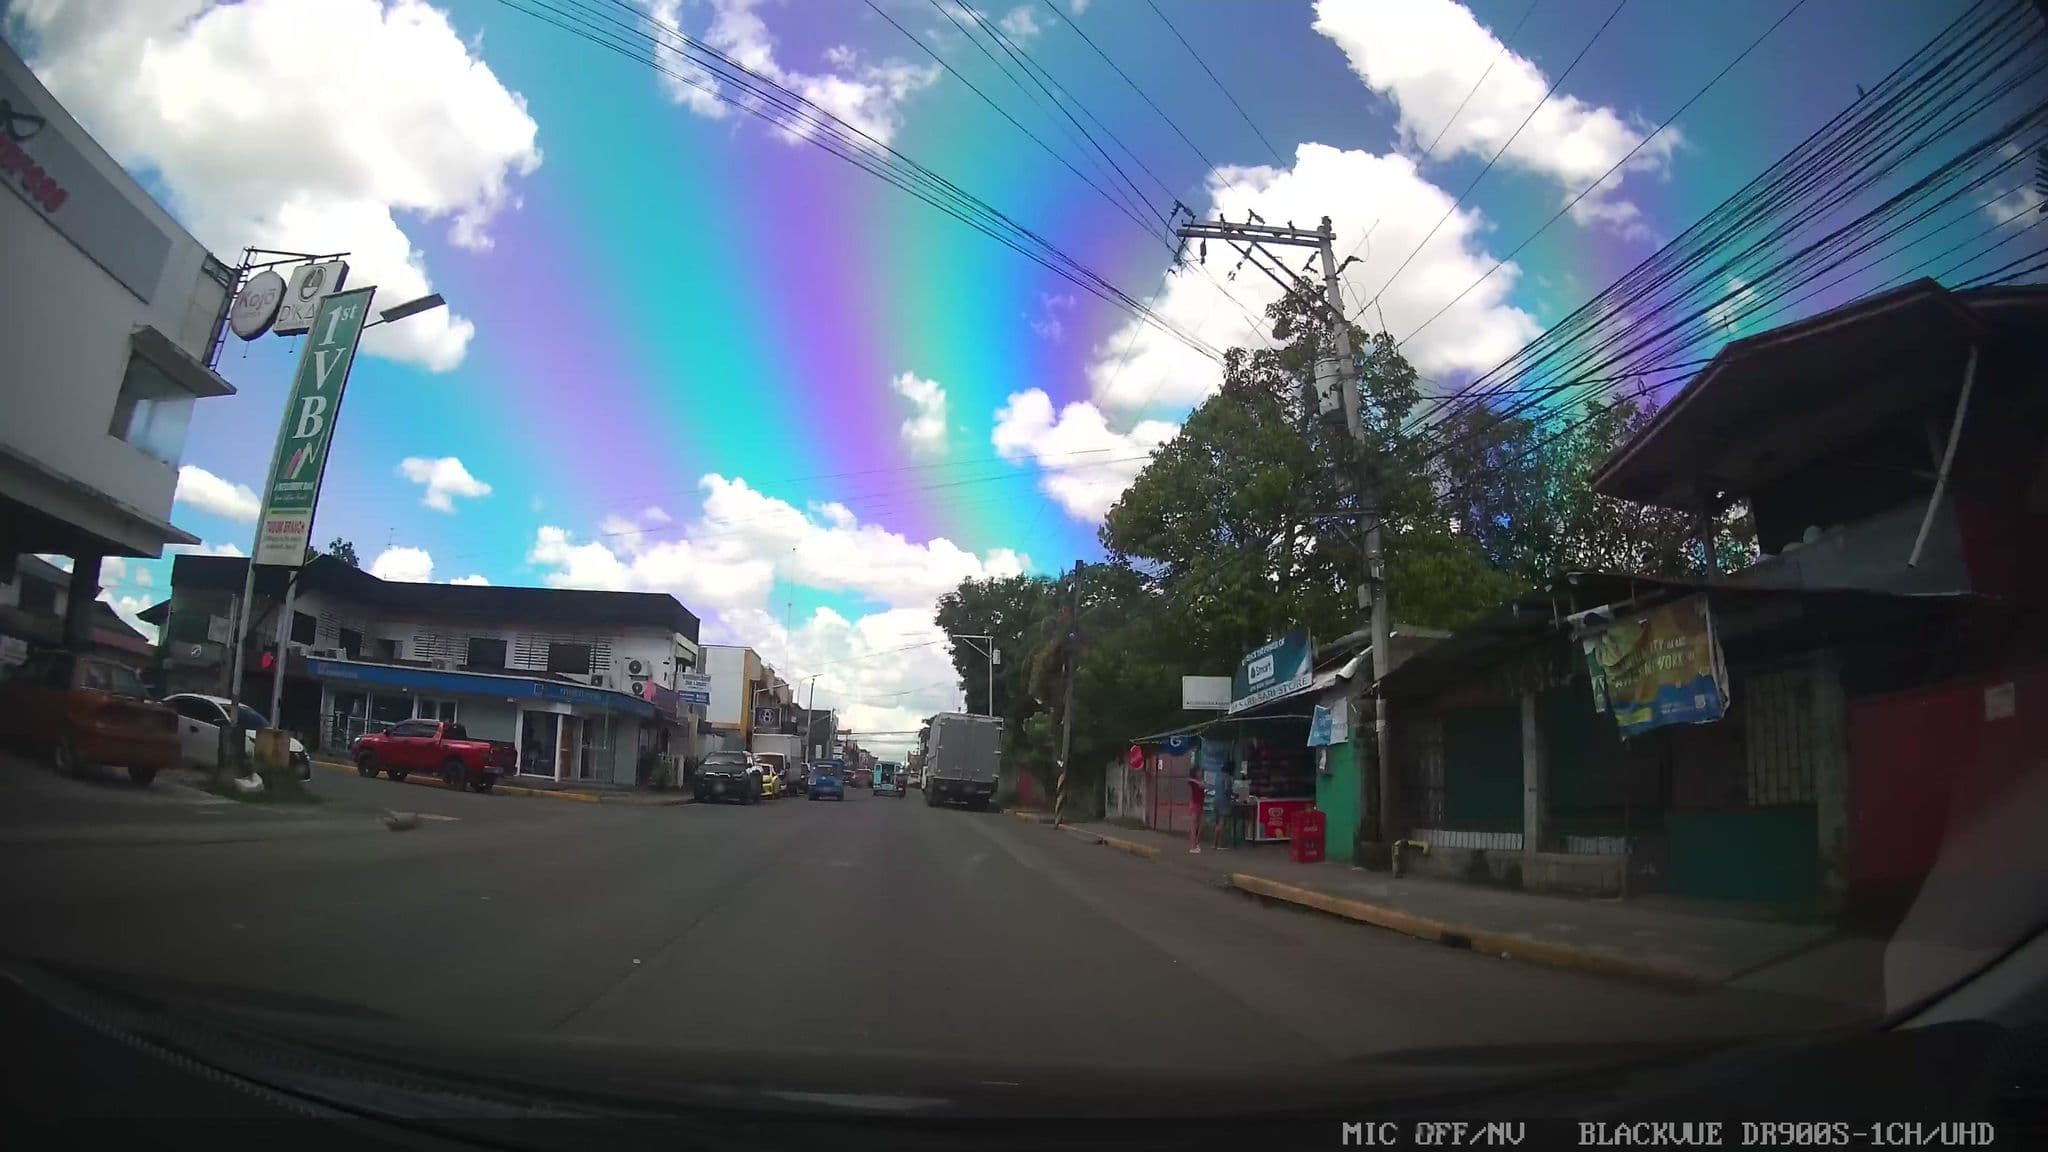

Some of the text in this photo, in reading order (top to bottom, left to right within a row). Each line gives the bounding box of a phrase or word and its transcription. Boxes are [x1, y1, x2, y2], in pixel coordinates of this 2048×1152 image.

[319, 304, 358, 346] 1st
[1256, 663, 1271, 676] Smart
[1278, 678, 1308, 695] STORE
